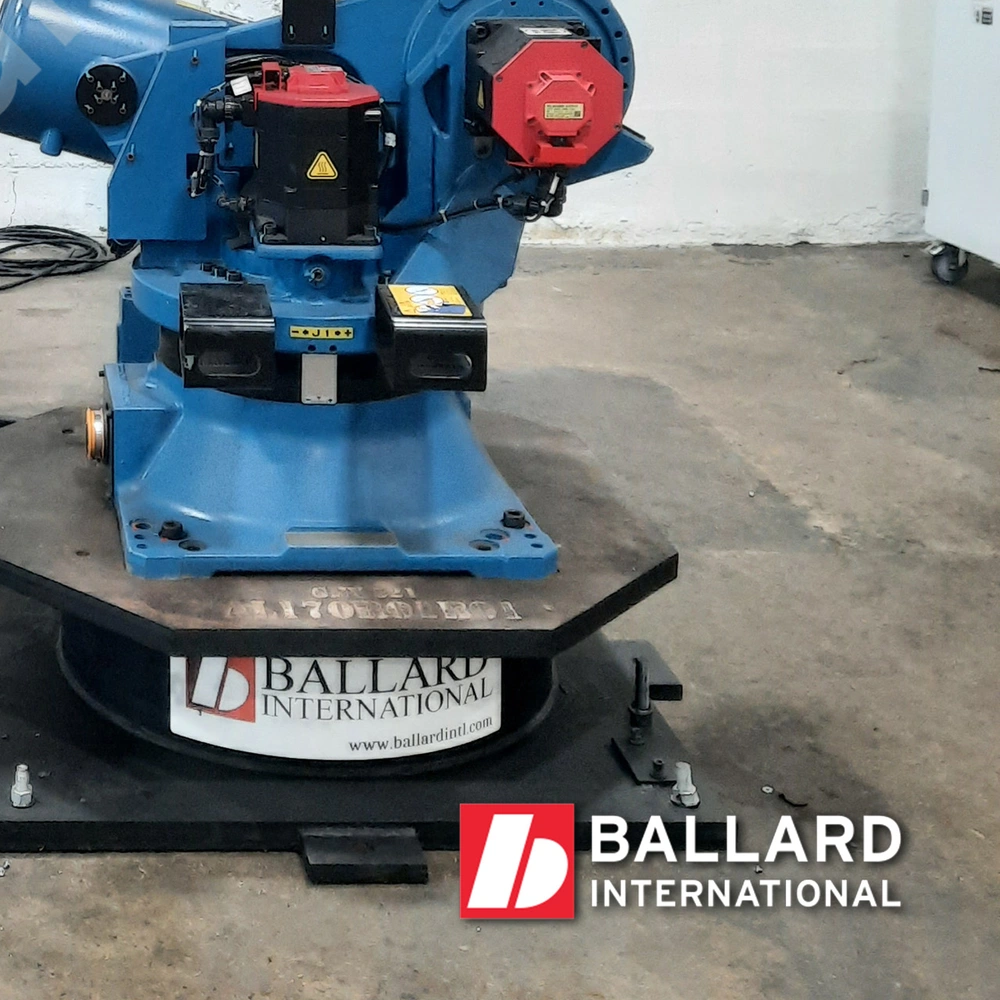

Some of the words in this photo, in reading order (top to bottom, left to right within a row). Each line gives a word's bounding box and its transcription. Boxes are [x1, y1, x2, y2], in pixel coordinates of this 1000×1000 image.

[262, 657, 487, 695] BALLARD
[262, 677, 494, 721] INTERNATIONAL
[349, 716, 493, 751] www.ballardintl.com
